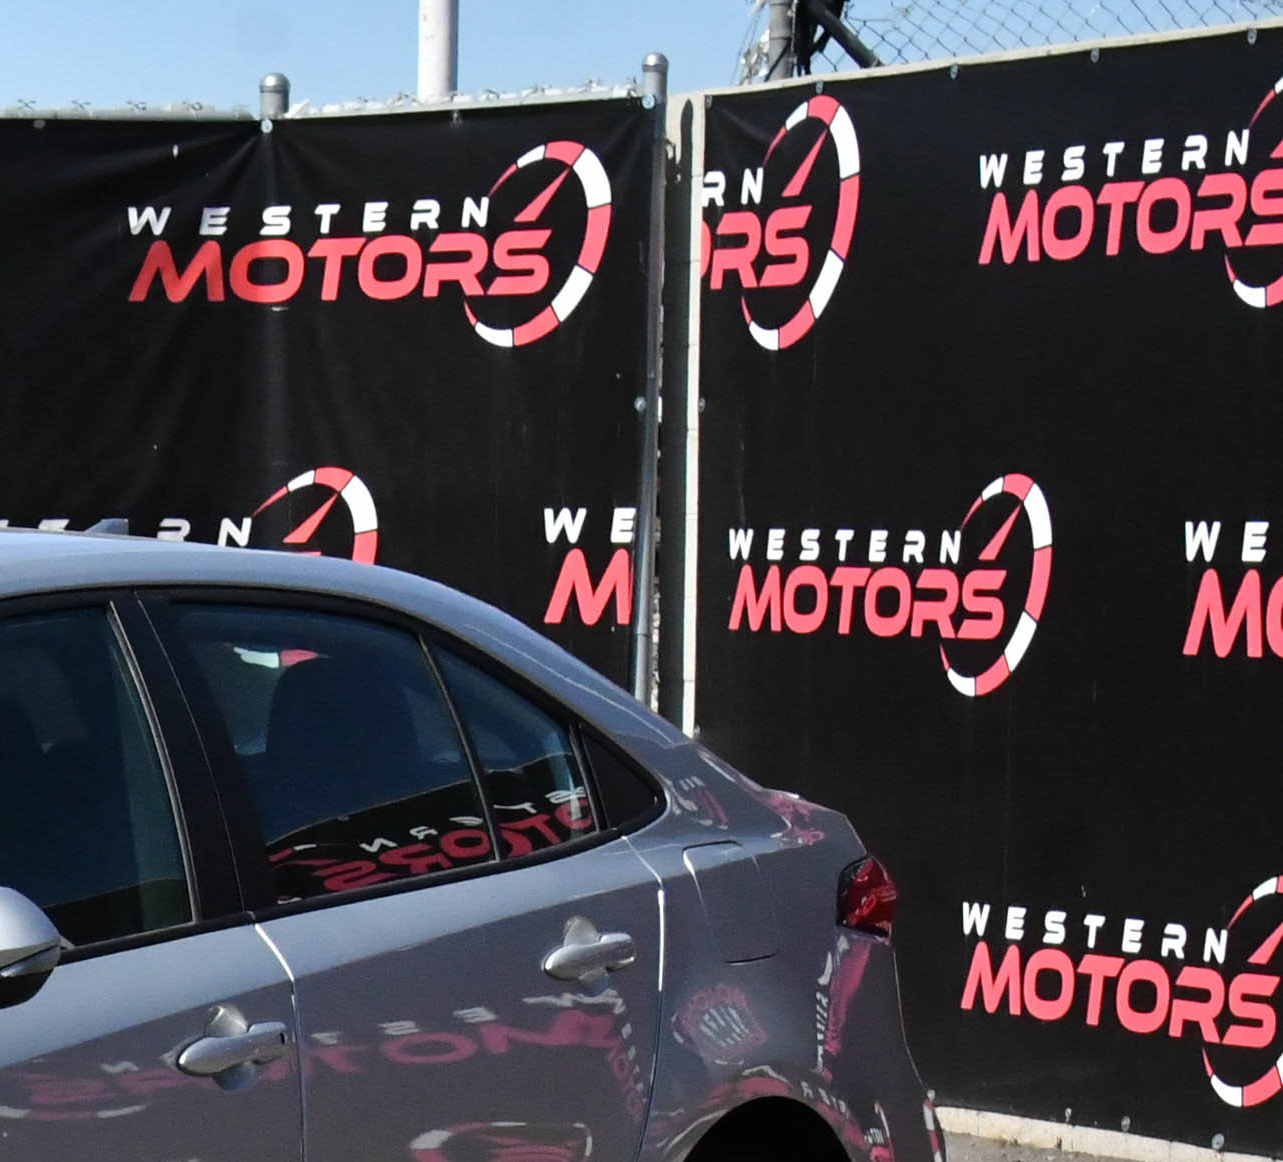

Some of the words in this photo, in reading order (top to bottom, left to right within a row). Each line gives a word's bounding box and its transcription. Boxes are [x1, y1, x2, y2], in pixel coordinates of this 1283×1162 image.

[979, 129, 1250, 190] WESTERN
[127, 197, 489, 238] WESTERN
[701, 205, 812, 290] RS
[978, 167, 1283, 267] MOTORS
[128, 228, 552, 303] MOTORS
[728, 528, 962, 564] WESTERN
[1184, 520, 1270, 562] WE
[728, 563, 1008, 641] MOTORS
[962, 902, 1228, 964] WESTERN
[961, 941, 1281, 1048] MOTORS
